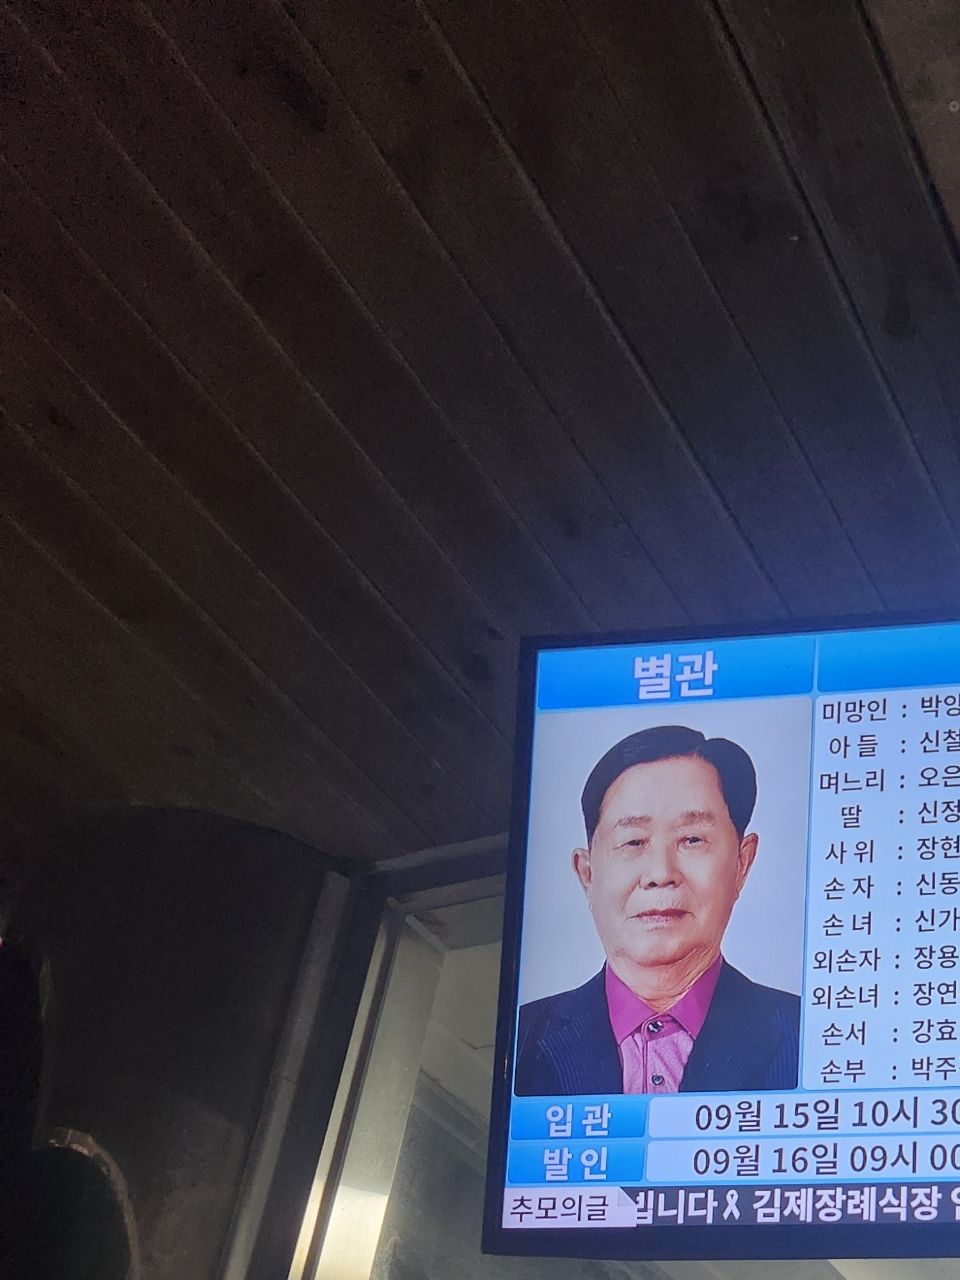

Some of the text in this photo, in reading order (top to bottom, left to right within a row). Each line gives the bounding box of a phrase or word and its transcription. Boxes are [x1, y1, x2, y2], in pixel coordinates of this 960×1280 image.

[633, 649, 719, 700] 별관
[821, 697, 887, 725] 미망인
[818, 767, 885, 795] 며느리
[840, 803, 863, 829] 딸
[811, 946, 882, 974] 외손자
[810, 982, 878, 1010] 외손녀
[820, 1019, 866, 1047] 손서
[819, 1058, 866, 1084] 손부
[694, 1098, 762, 1133] 09월
[772, 1097, 840, 1131] 15일
[851, 1095, 919, 1129] 10시
[692, 1143, 760, 1177] 09월
[771, 1141, 838, 1176] 16일
[849, 1140, 918, 1174] 09시
[509, 1194, 610, 1223] 추모의글
[751, 1184, 943, 1224] 김제장례식장
